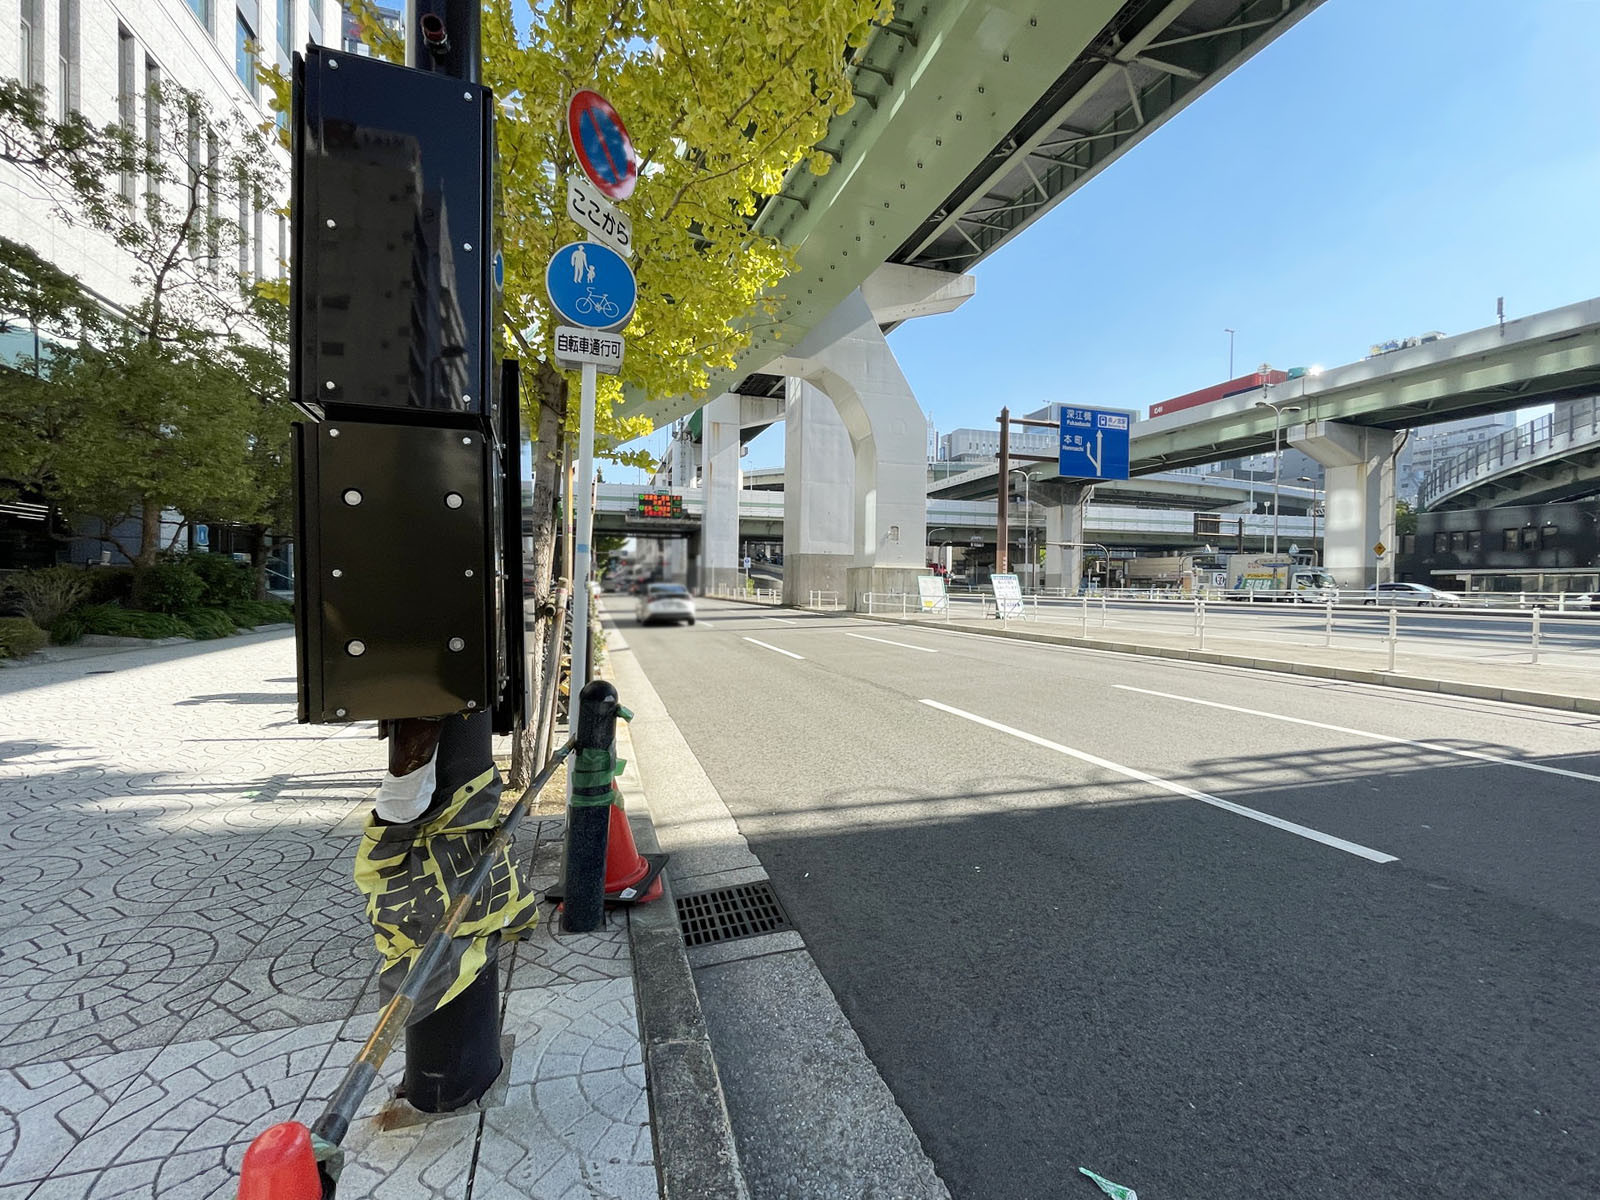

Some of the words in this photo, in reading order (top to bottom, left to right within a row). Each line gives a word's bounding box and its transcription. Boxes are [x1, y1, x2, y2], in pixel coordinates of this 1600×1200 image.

[573, 188, 628, 245] ここから
[558, 334, 621, 358] 自転車通行可
[1064, 435, 1083, 445] 本町
